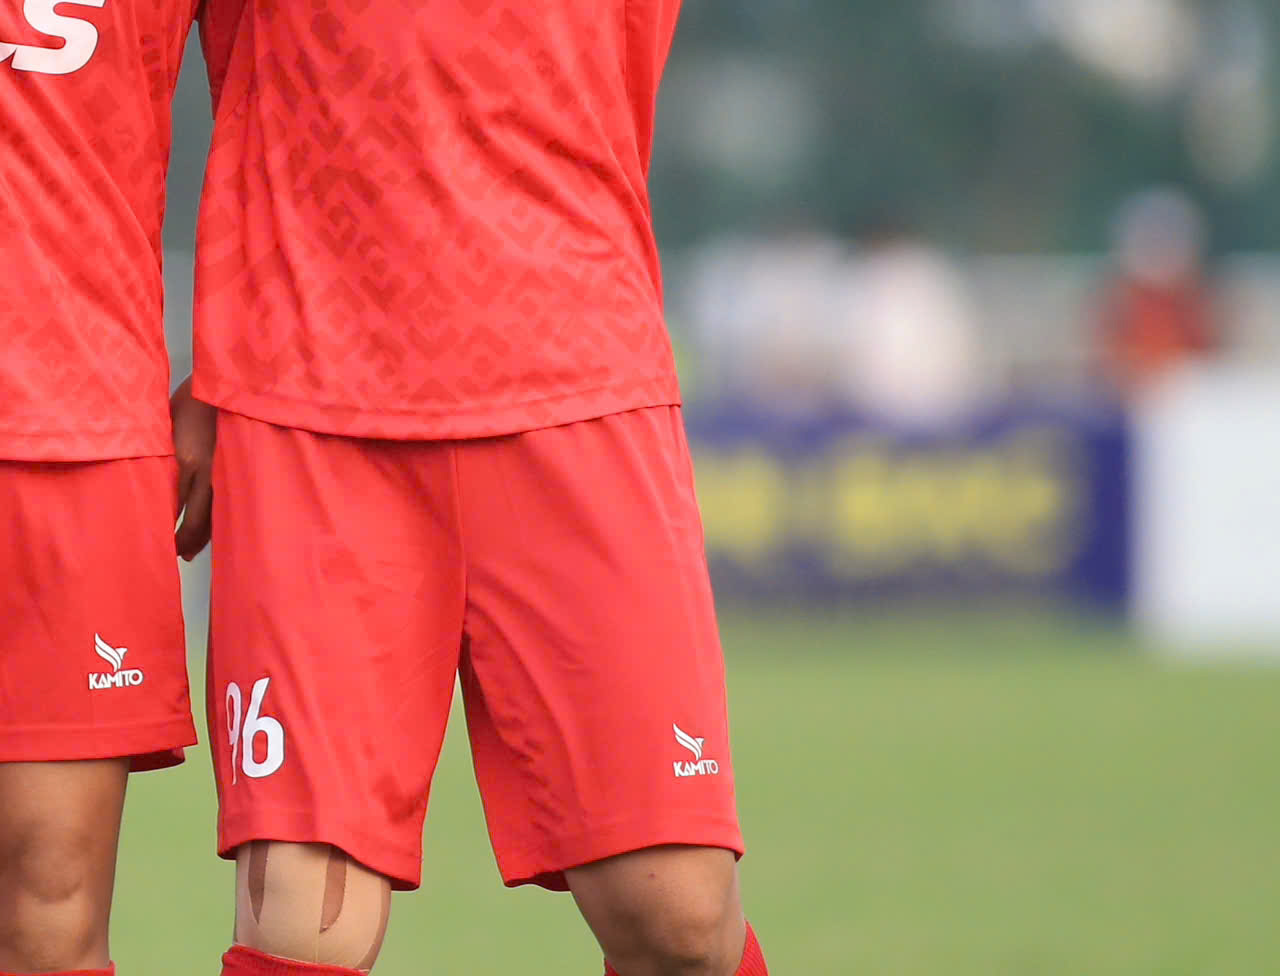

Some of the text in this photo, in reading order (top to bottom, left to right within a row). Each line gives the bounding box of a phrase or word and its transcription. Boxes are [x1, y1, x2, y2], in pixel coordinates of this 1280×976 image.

[88, 669, 144, 690] KAMITO
[225, 677, 285, 786] 96
[672, 759, 719, 777] KAMITO
